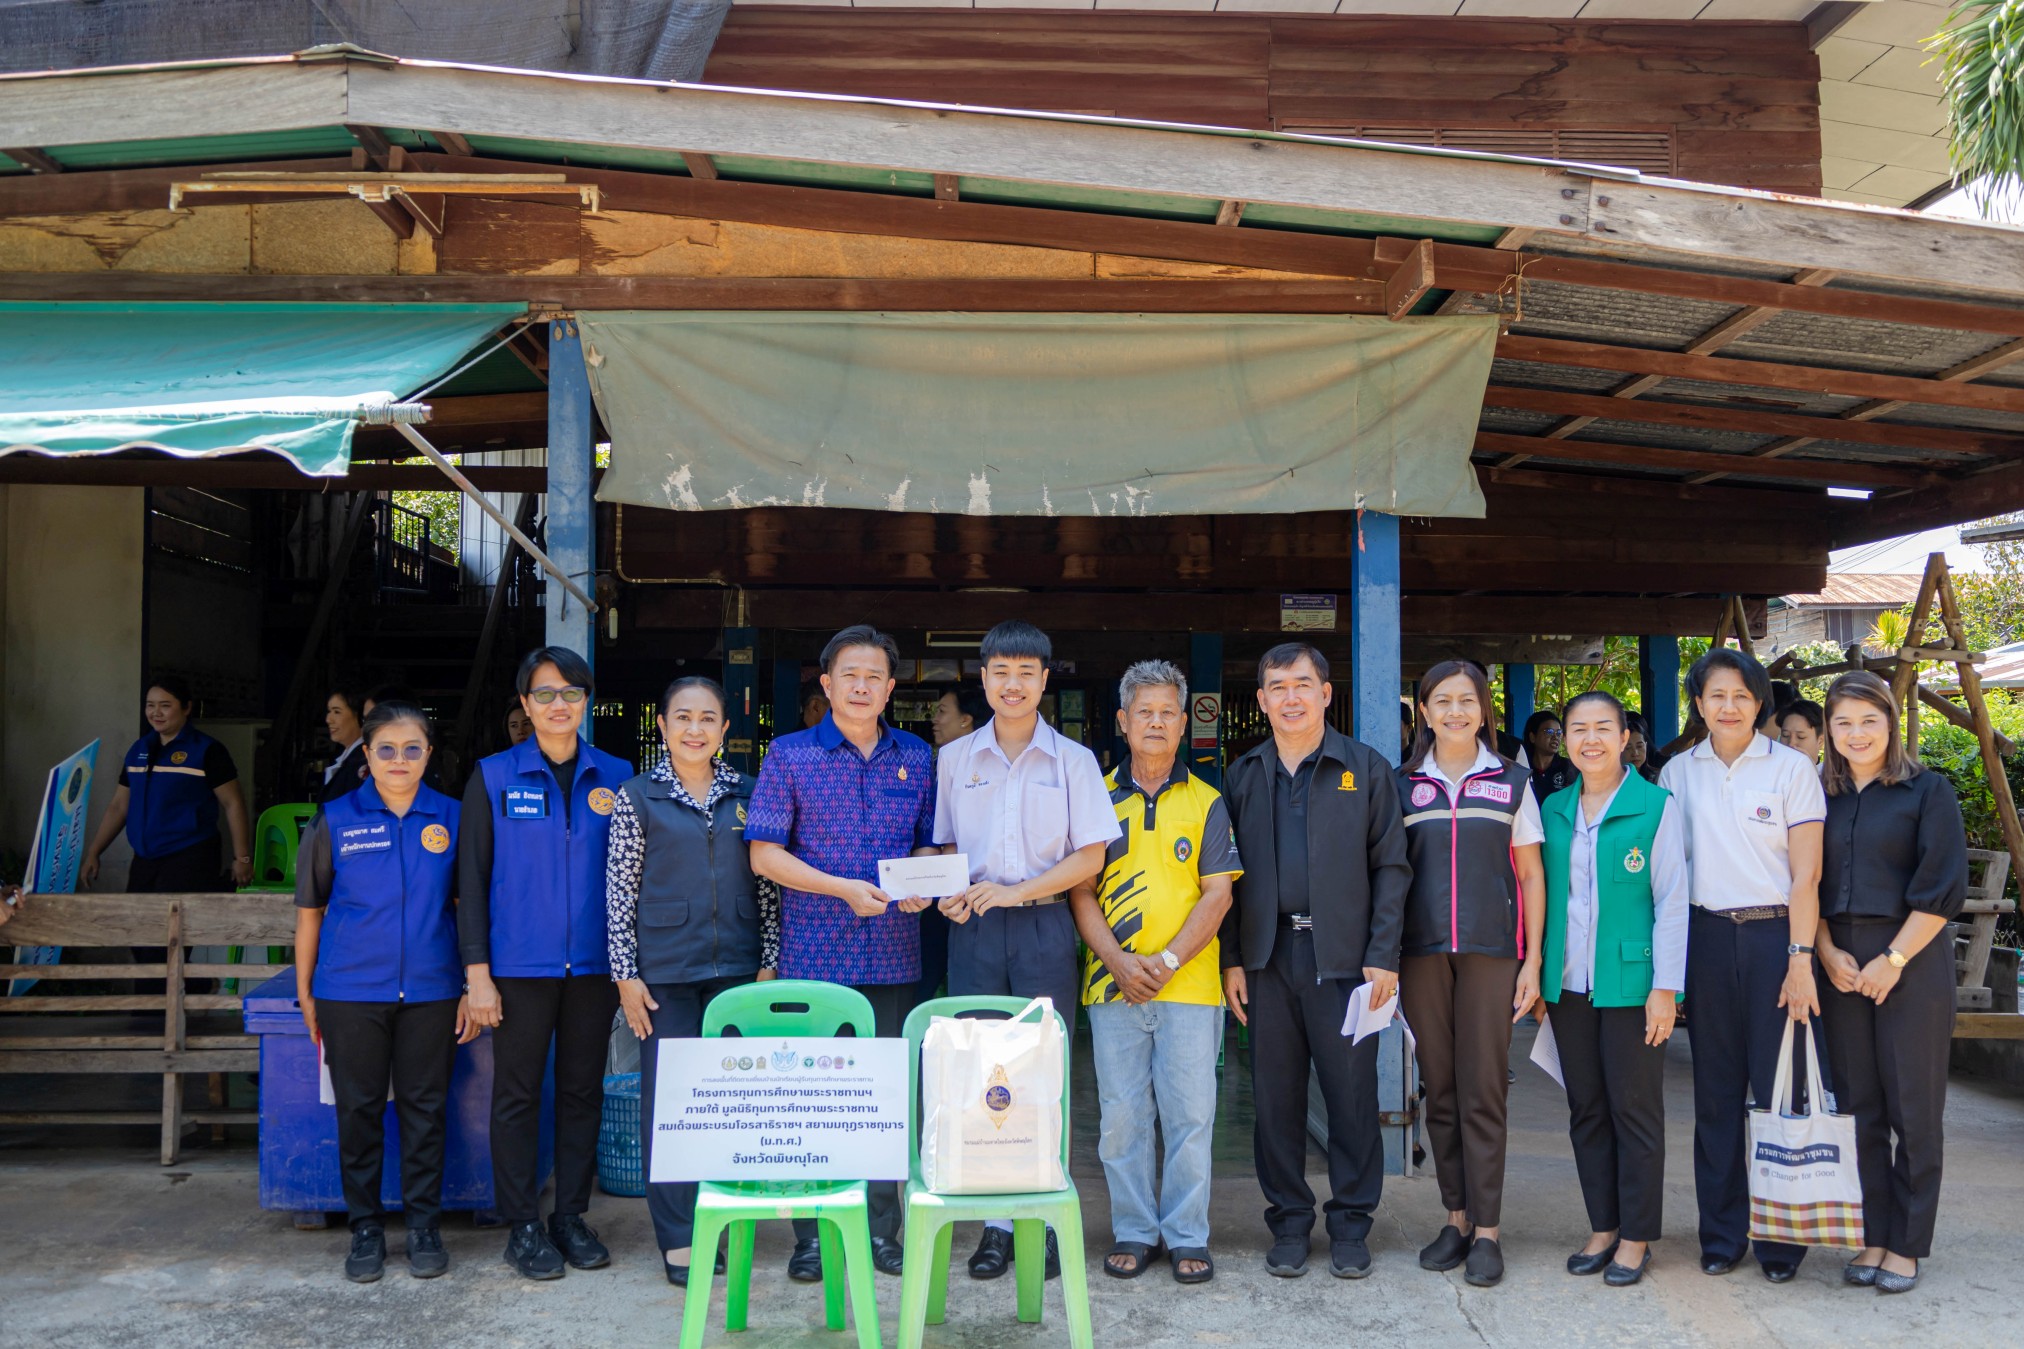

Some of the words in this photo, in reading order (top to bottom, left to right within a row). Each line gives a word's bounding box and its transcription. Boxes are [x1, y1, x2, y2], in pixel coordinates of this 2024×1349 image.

[1487, 789, 1508, 799] 1300
[692, 1087, 872, 1100] โครงการทุนการศึกษาพระราชทานฯ
[685, 1103, 719, 1114] ภายใต้
[722, 1102, 878, 1117] มูลนิธิทุนการศึกษาพระราชทาน
[658, 1119, 802, 1131] สมเด็จพระบรมโอรสาธิราชฯ
[760, 1136, 802, 1147] (ม.ท.ศ.)
[732, 1152, 829, 1167] จังหวัดพิษณุโลก
[1759, 1147, 1834, 1161] กรมการพัฒนาชุมชน
[1771, 1170, 1798, 1181] Change
[1801, 1172, 1811, 1180] for
